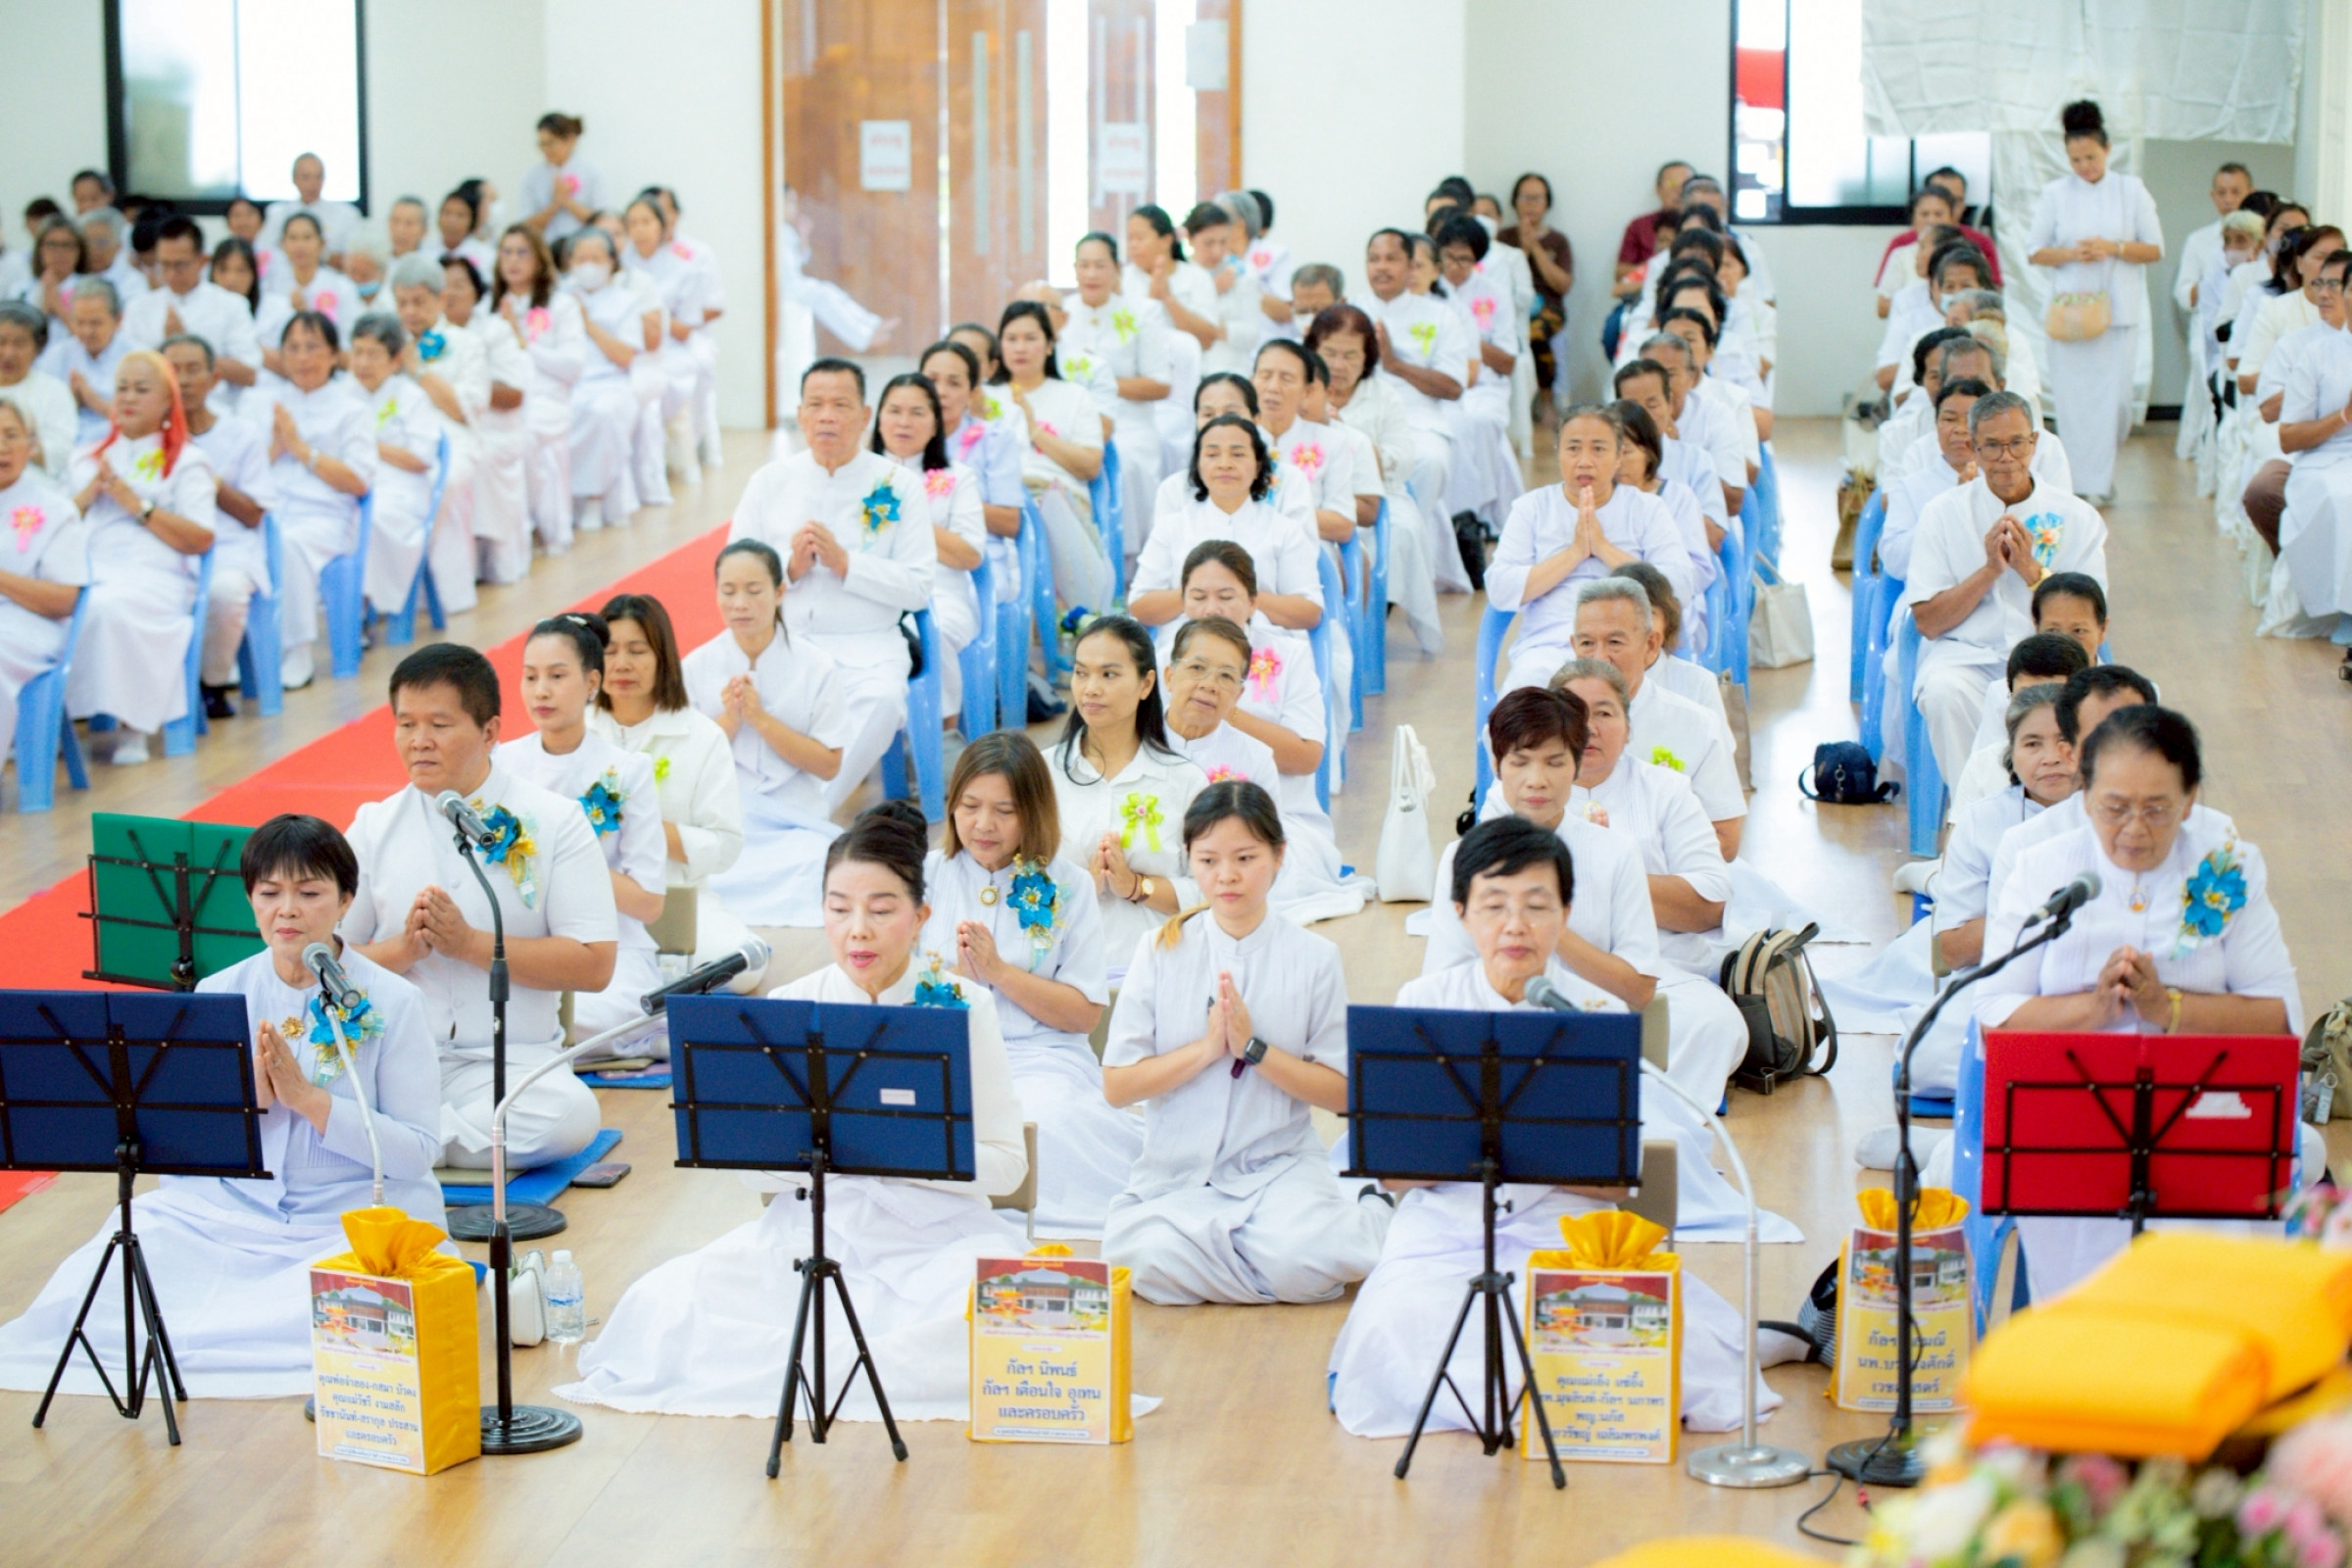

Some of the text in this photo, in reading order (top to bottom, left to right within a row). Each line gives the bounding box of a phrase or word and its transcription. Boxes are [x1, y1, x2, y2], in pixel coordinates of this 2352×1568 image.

[999, 1402, 1086, 1420] และครอบครัว
[345, 1430, 398, 1446] และครอบครัว
